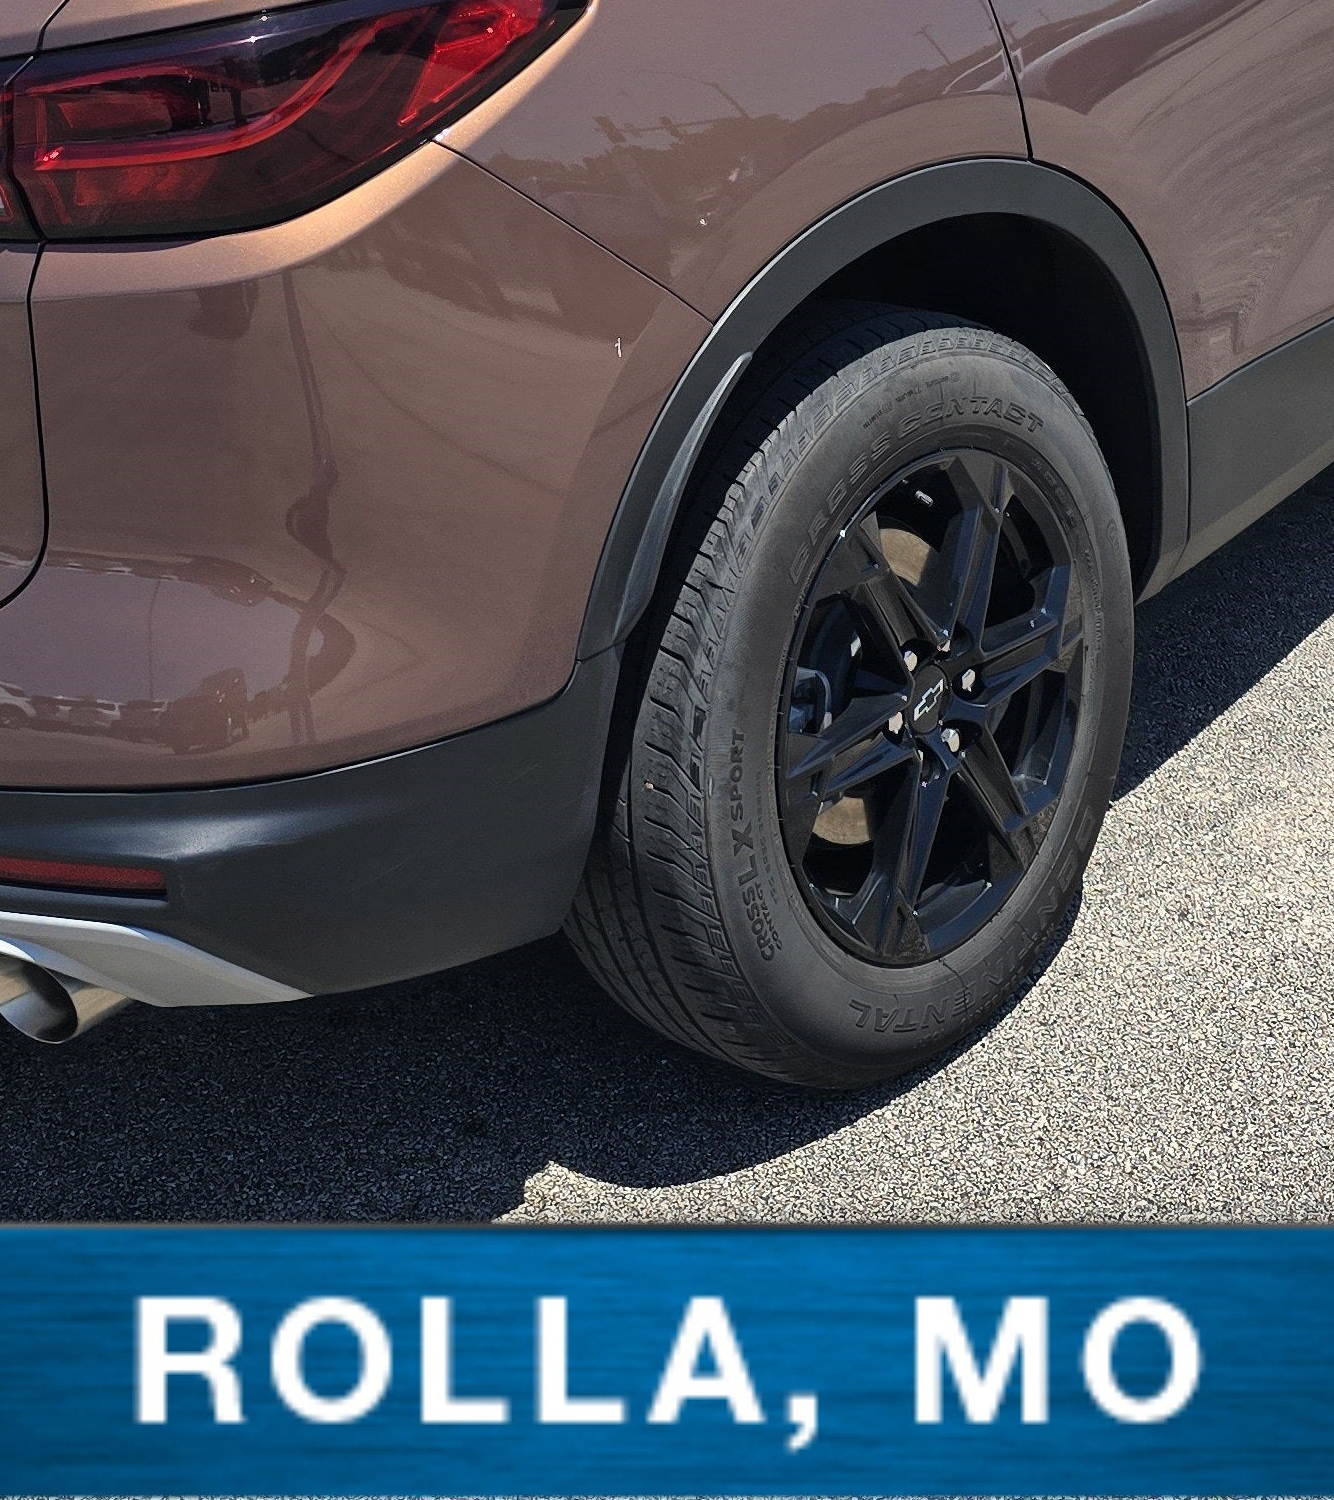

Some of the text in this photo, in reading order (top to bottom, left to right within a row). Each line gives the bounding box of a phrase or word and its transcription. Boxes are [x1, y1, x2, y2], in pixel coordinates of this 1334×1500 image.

[729, 727, 745, 822] SPORT
[731, 820, 759, 887] LX
[741, 885, 775, 962] CROSS
